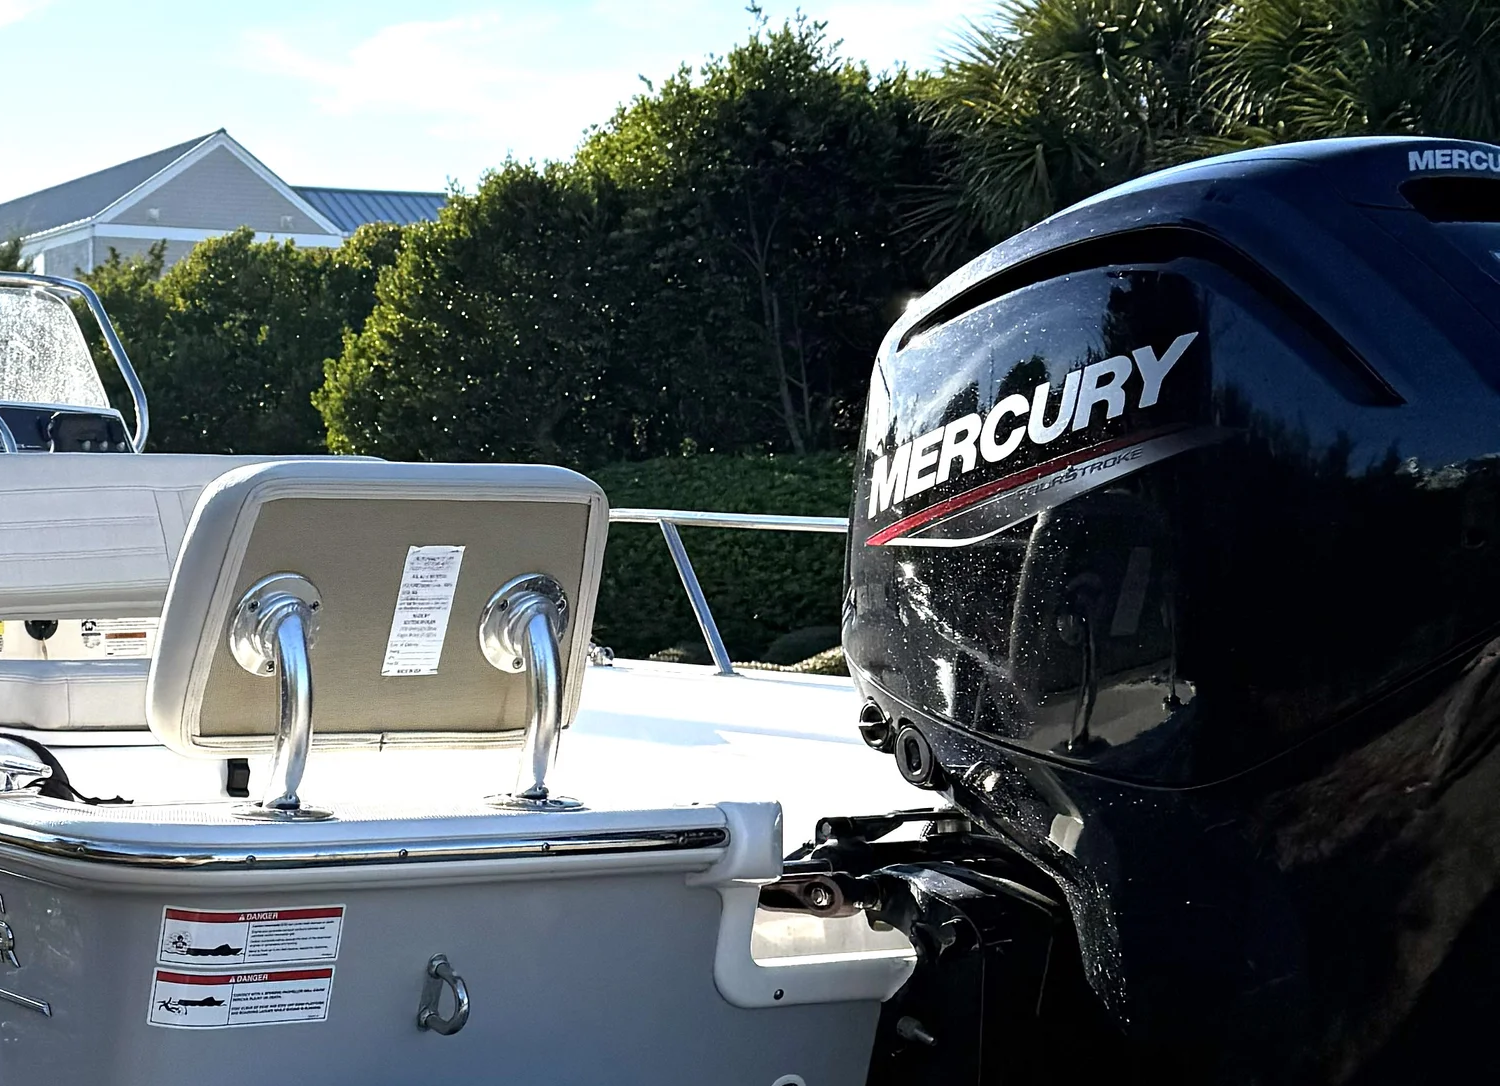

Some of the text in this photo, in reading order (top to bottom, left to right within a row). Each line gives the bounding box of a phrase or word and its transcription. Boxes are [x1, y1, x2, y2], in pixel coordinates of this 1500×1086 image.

[867, 331, 1199, 520] MERCURY
[245, 912, 279, 921] DANGER
[236, 974, 269, 982] DANGER
